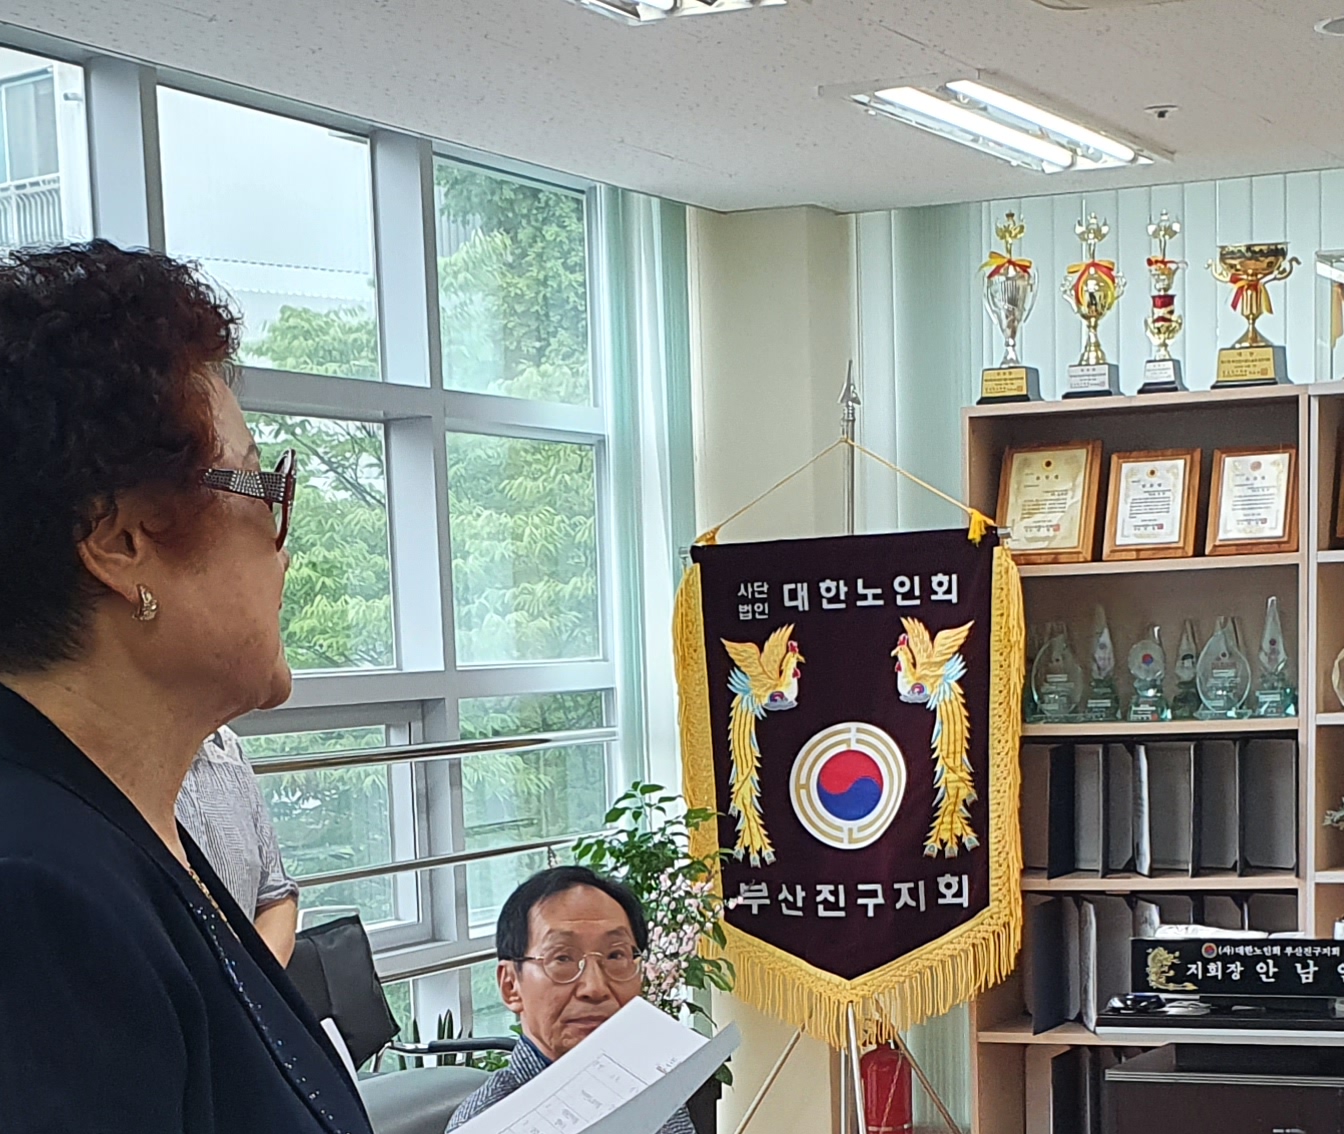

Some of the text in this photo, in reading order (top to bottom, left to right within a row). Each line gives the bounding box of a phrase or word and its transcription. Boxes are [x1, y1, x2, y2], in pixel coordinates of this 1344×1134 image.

[737, 581, 769, 599] 사단
[783, 573, 959, 612] 대한노인회
[738, 602, 769, 621] 법인
[739, 873, 969, 917] 부산진구지회
[1186, 961, 1244, 980] 지회장
